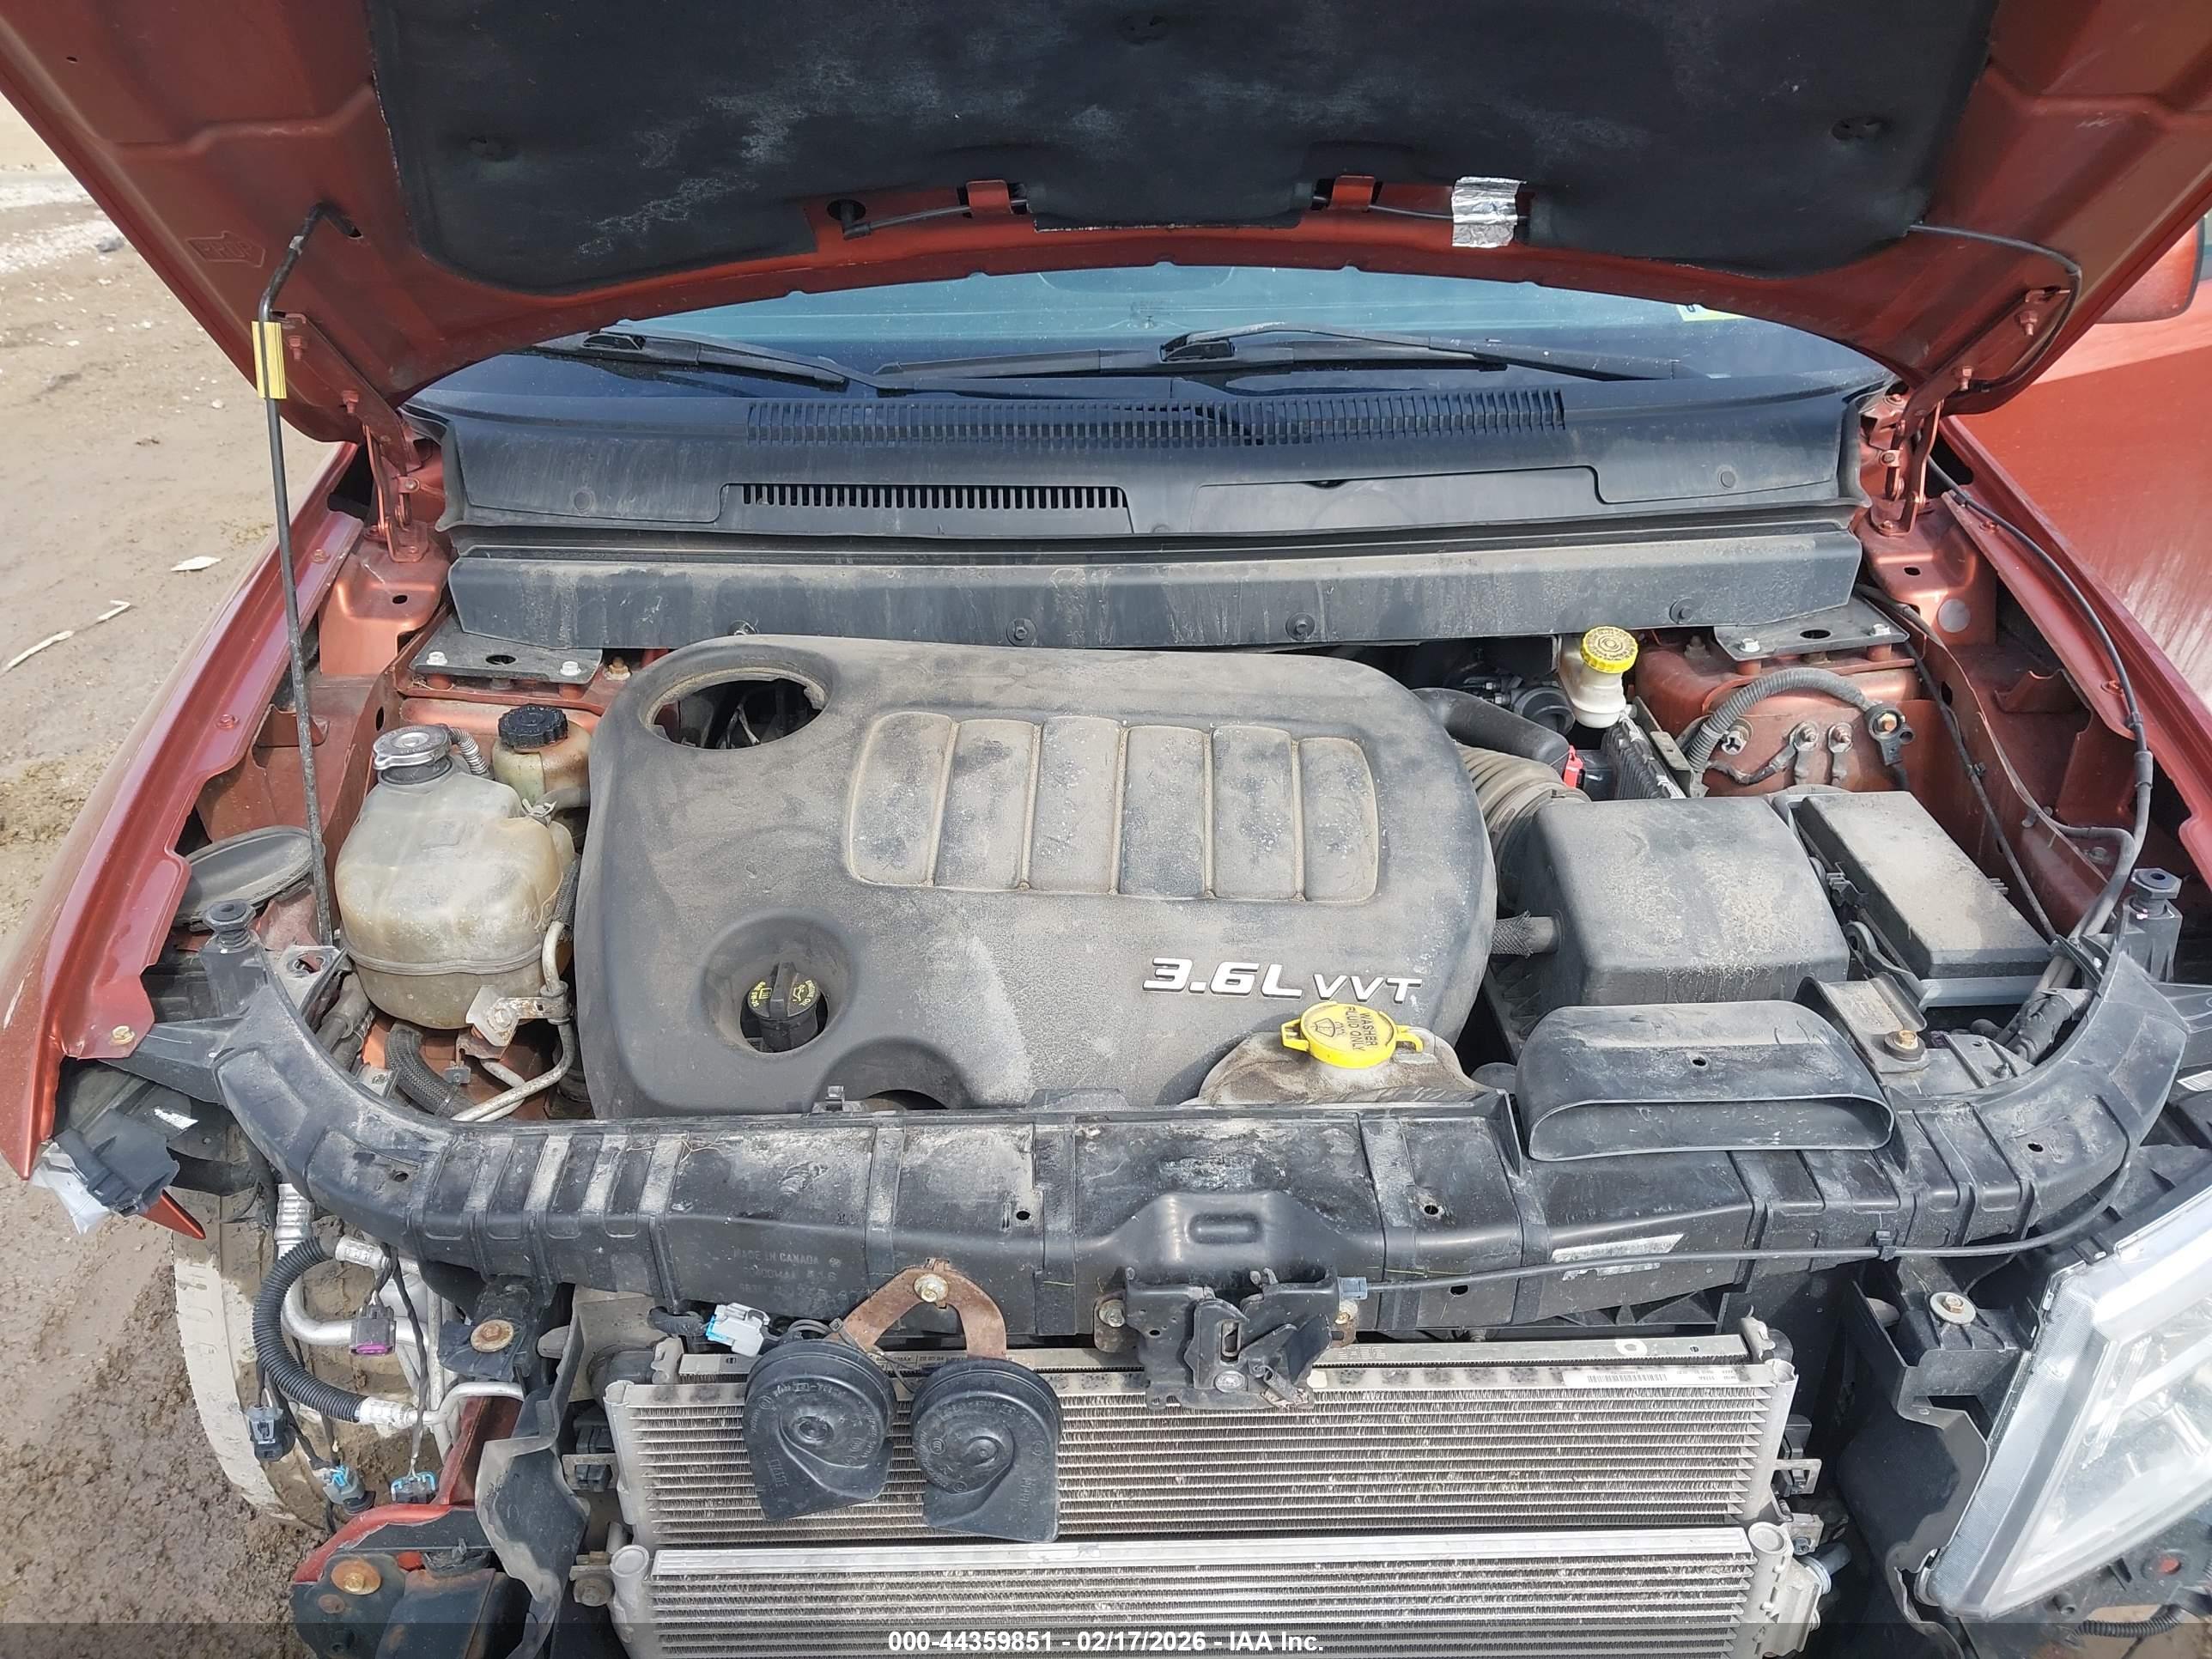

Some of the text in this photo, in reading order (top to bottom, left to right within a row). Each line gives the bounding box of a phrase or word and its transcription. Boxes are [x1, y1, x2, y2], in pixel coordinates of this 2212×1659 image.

[1143, 957, 1423, 1004] 3.6L VVT
[1346, 1006, 1366, 1051] FLUID ONLY
[1360, 1012, 1378, 1047] WASHER
[779, 1252, 819, 1265] CANADA
